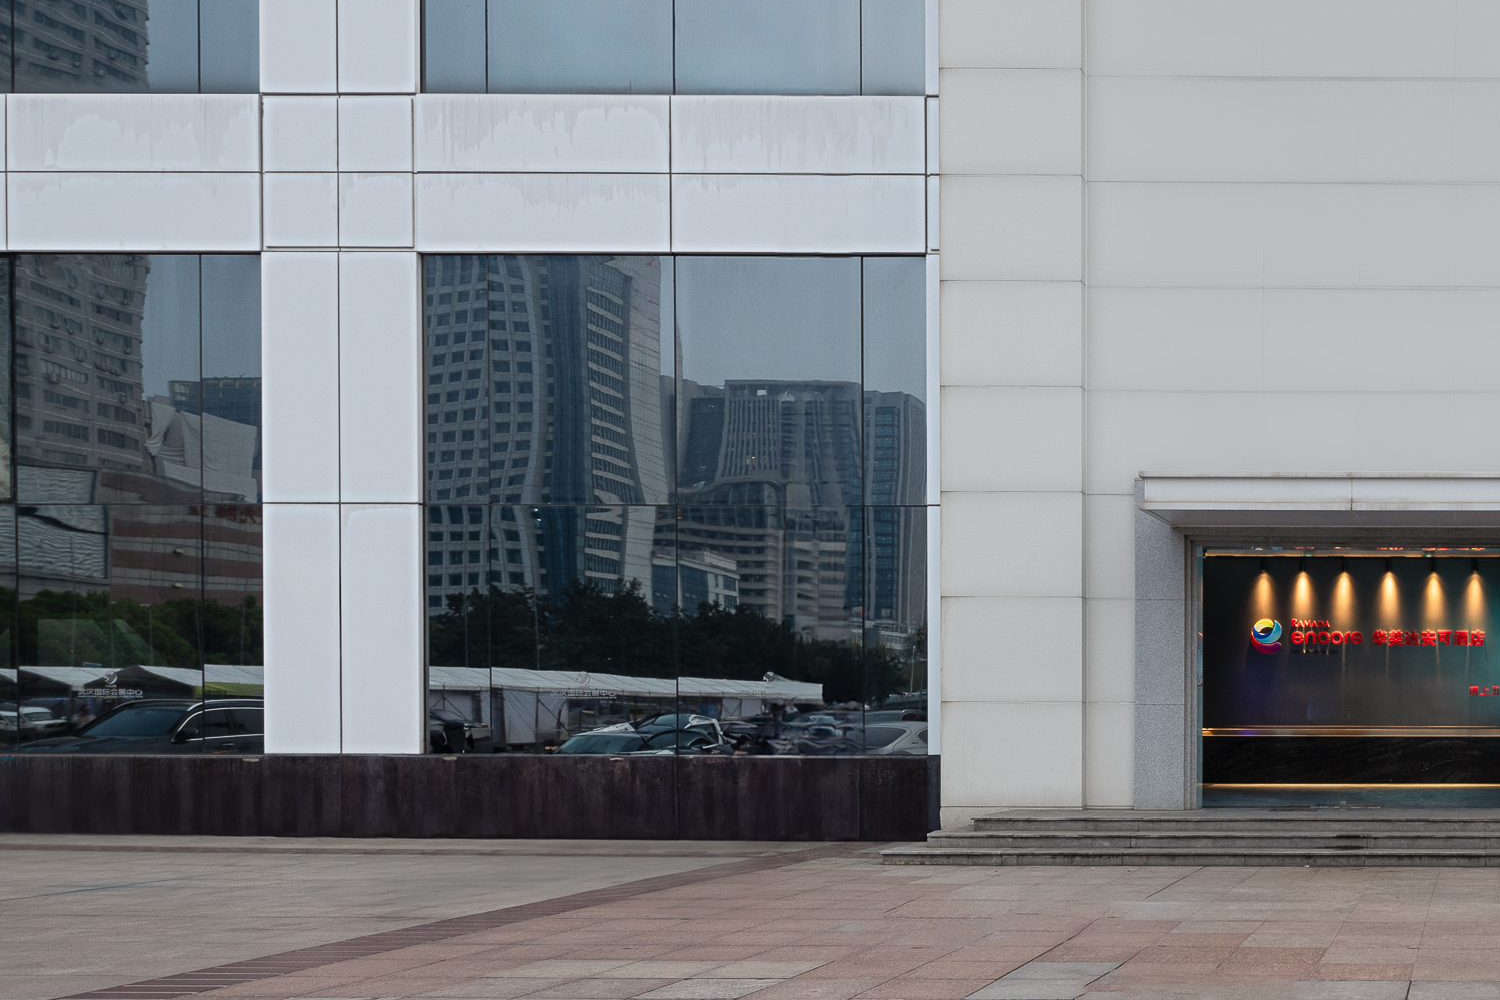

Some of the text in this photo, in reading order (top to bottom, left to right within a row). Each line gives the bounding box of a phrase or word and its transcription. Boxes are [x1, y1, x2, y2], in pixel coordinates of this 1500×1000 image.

[1291, 618, 1331, 628] RAMADA
[1291, 630, 1363, 645] encore
[1371, 629, 1485, 647] 华美达安可酒店
